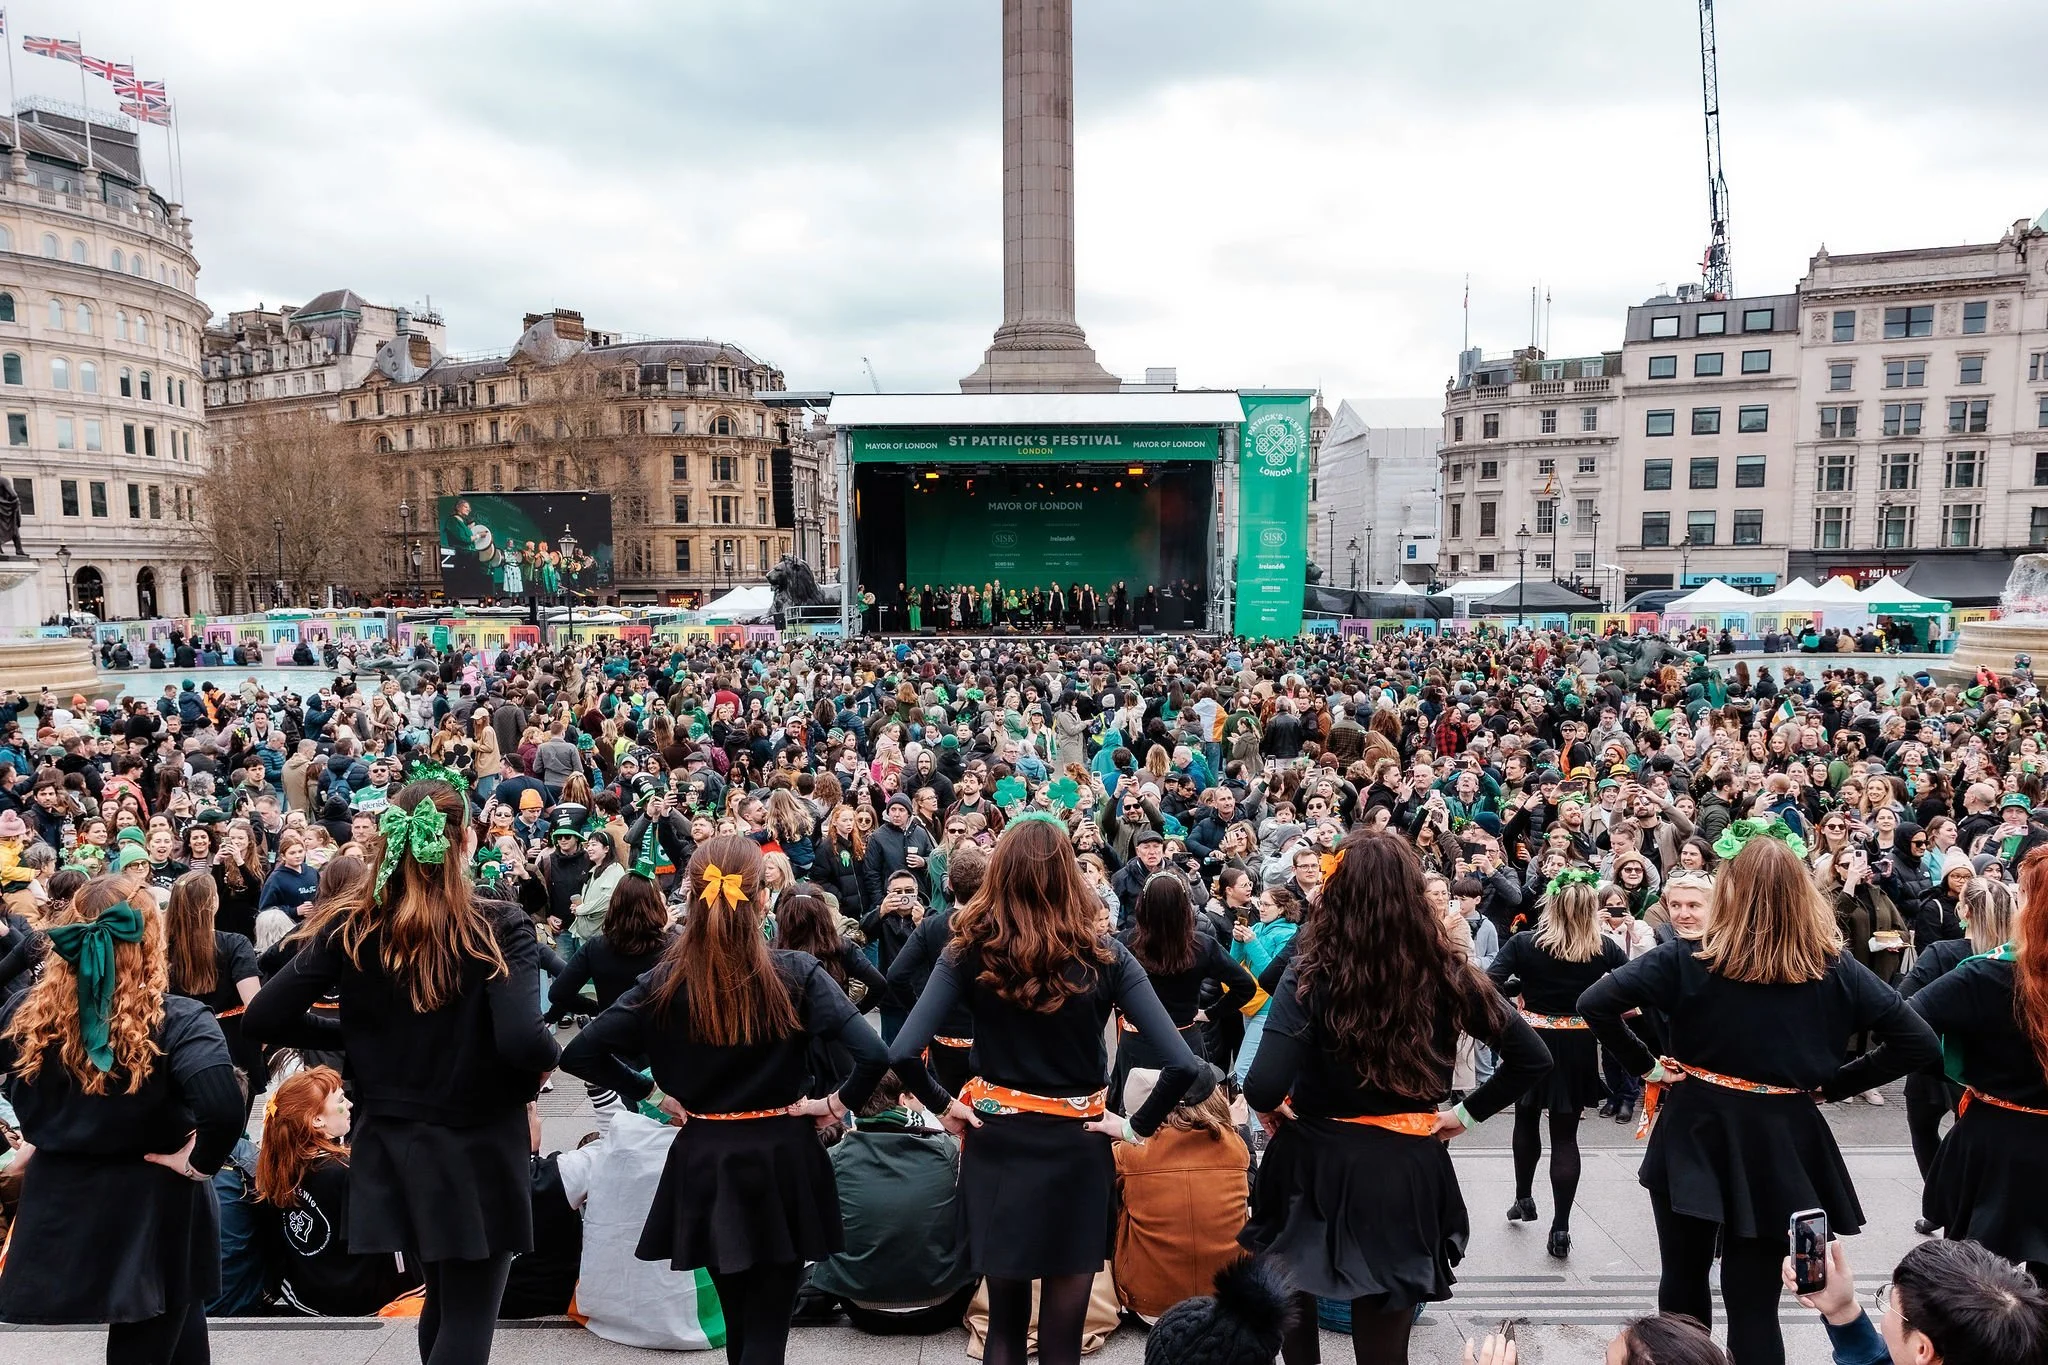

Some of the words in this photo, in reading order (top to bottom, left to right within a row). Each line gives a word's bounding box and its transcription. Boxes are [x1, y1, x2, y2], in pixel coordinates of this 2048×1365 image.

[1247, 413, 1284, 436] PATRICK'S
[1284, 416, 1307, 448] FESTIVAL
[865, 442, 892, 450] MAYOR
[892, 442, 904, 450] OF
[904, 442, 938, 450] LONDON
[948, 436, 967, 446] ST
[971, 435, 1048, 446] PATRICK'S
[1052, 435, 1122, 446] FESTIVAL
[1133, 440, 1160, 448] MAYOR
[1160, 440, 1172, 448] OF
[1172, 440, 1206, 448] LONDON
[1244, 437, 1252, 448] ST
[1017, 447, 1053, 455] LONDON
[1259, 466, 1293, 477] LONDON
[988, 502, 1022, 511] MAYOR
[1024, 502, 1038, 511] OF
[1039, 501, 1083, 511] LONDON
[994, 534, 1015, 543] SISK
[1263, 532, 1284, 542] SISK
[1731, 576, 1762, 584] NERO
[1724, 618, 1745, 633] LOVED
[272, 628, 295, 644] LOVED
[363, 625, 384, 640] LOVED
[484, 633, 505, 650] LOVED
